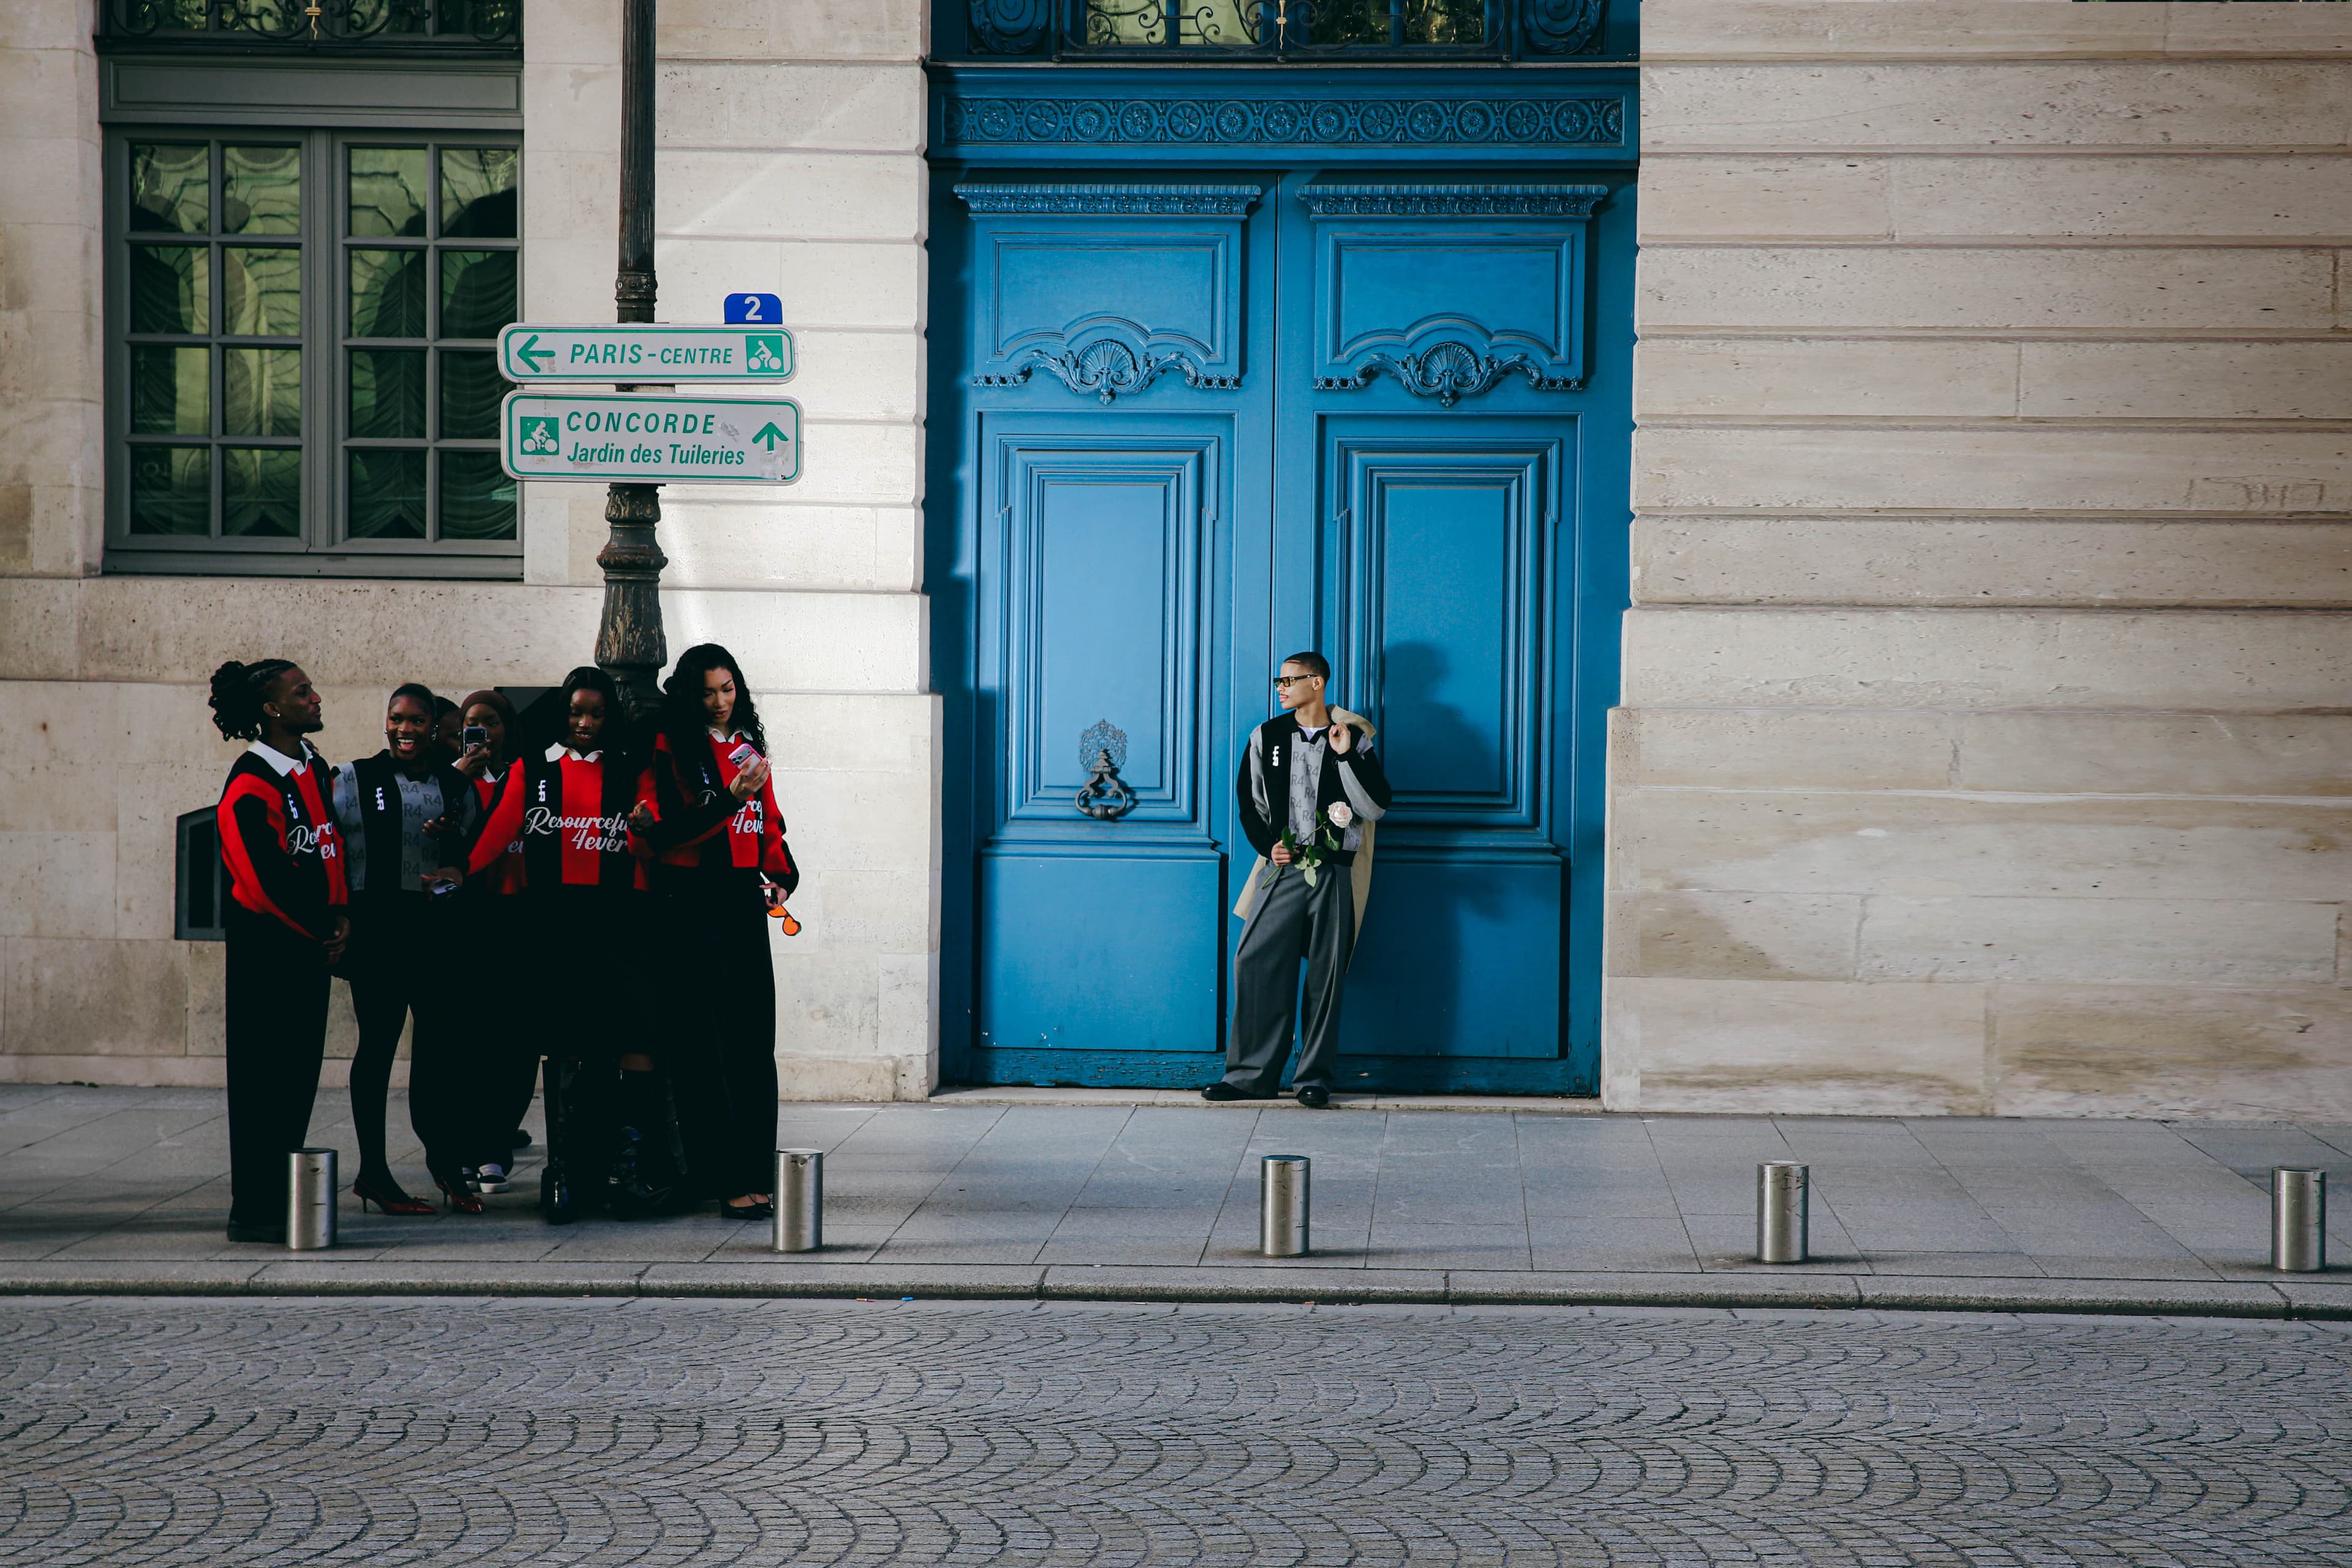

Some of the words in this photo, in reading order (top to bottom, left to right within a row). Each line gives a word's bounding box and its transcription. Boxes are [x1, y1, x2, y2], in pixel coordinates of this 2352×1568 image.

[744, 296, 763, 320] 2
[566, 411, 716, 435] CONCORDE
[567, 442, 625, 464] Jardin
[630, 443, 663, 464] des
[669, 443, 745, 466] Tuileries
[1292, 751, 1307, 764] R4
[1306, 764, 1320, 778] R4
[1291, 774, 1305, 787] R4
[400, 783, 420, 794] R4
[1305, 786, 1316, 800] R4
[423, 793, 442, 807] R4
[1290, 796, 1303, 810] R4
[404, 803, 423, 818] R4
[1302, 810, 1316, 823] R4
[525, 807, 628, 837] Resourcefu
[731, 813, 764, 834] 4eve
[403, 831, 420, 847] R4
[571, 829, 629, 853] 4ever
[402, 861, 421, 876] R4
